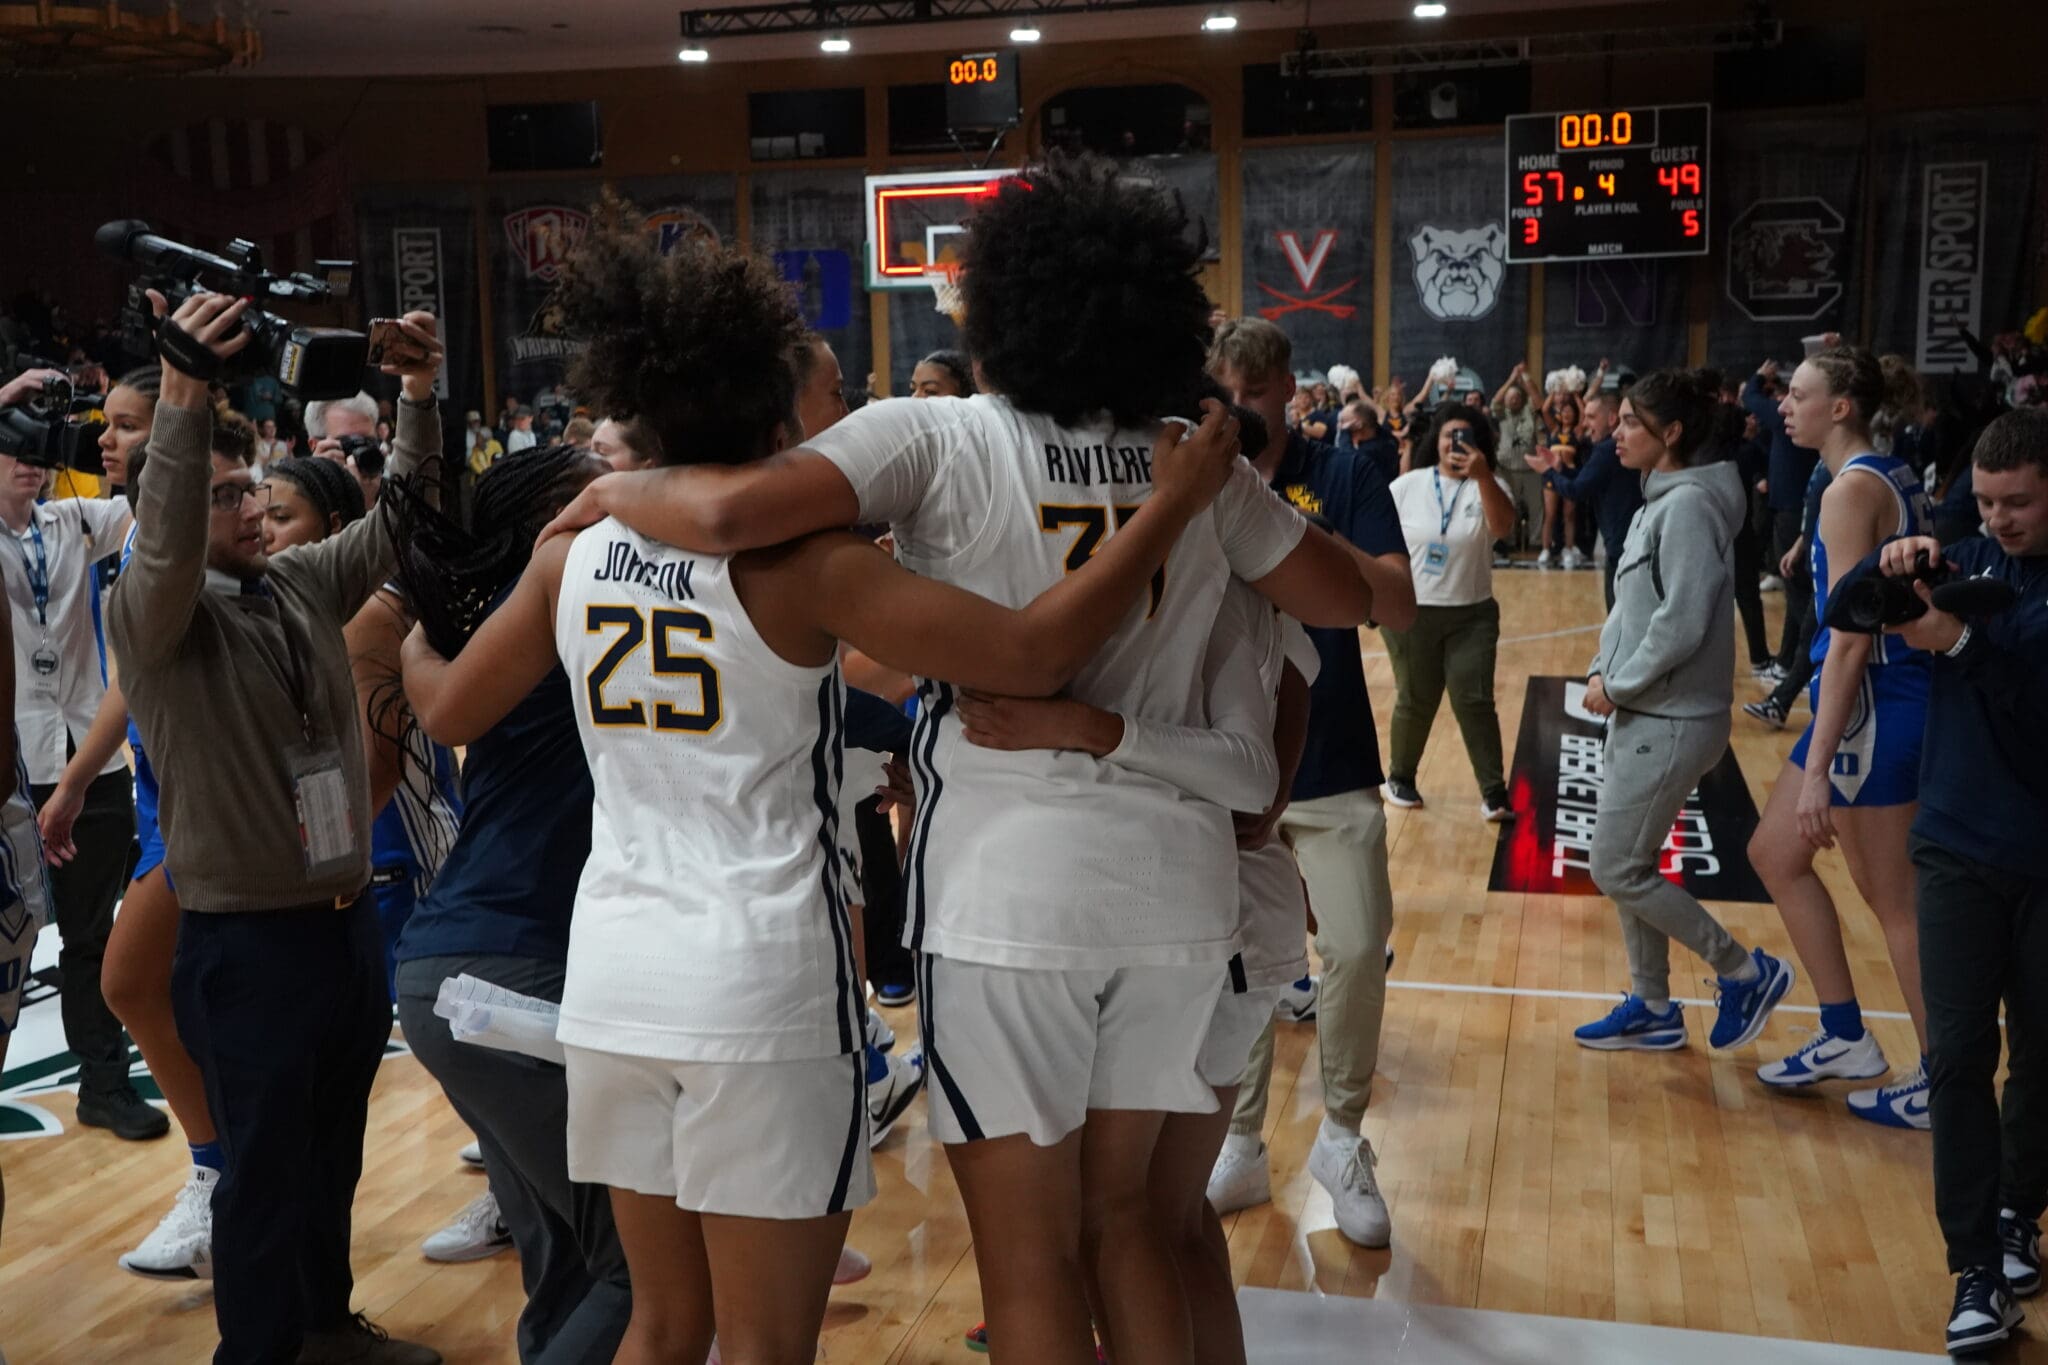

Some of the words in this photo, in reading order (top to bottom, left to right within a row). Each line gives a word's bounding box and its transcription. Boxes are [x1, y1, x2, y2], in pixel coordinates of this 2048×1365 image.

[949, 58, 998, 86] 00.0
[1561, 111, 1632, 148] 00.0
[1518, 153, 1560, 171] HOME
[1650, 145, 1699, 164] GUEST
[1523, 171, 1565, 206] 57
[1598, 173, 1616, 197] 4
[1657, 163, 1701, 197] 49
[1511, 207, 1543, 219] FOULS
[1575, 203, 1613, 217] PLAYER
[1614, 201, 1640, 215] FOUL
[1670, 198, 1703, 211] FOULS
[1523, 217, 1540, 245] 3
[1682, 209, 1700, 237] 5
[1587, 242, 1624, 255] MATCH
[594, 541, 695, 600] JOHSON
[586, 604, 724, 735] 25
[1551, 732, 1605, 879] BASKETBALL
